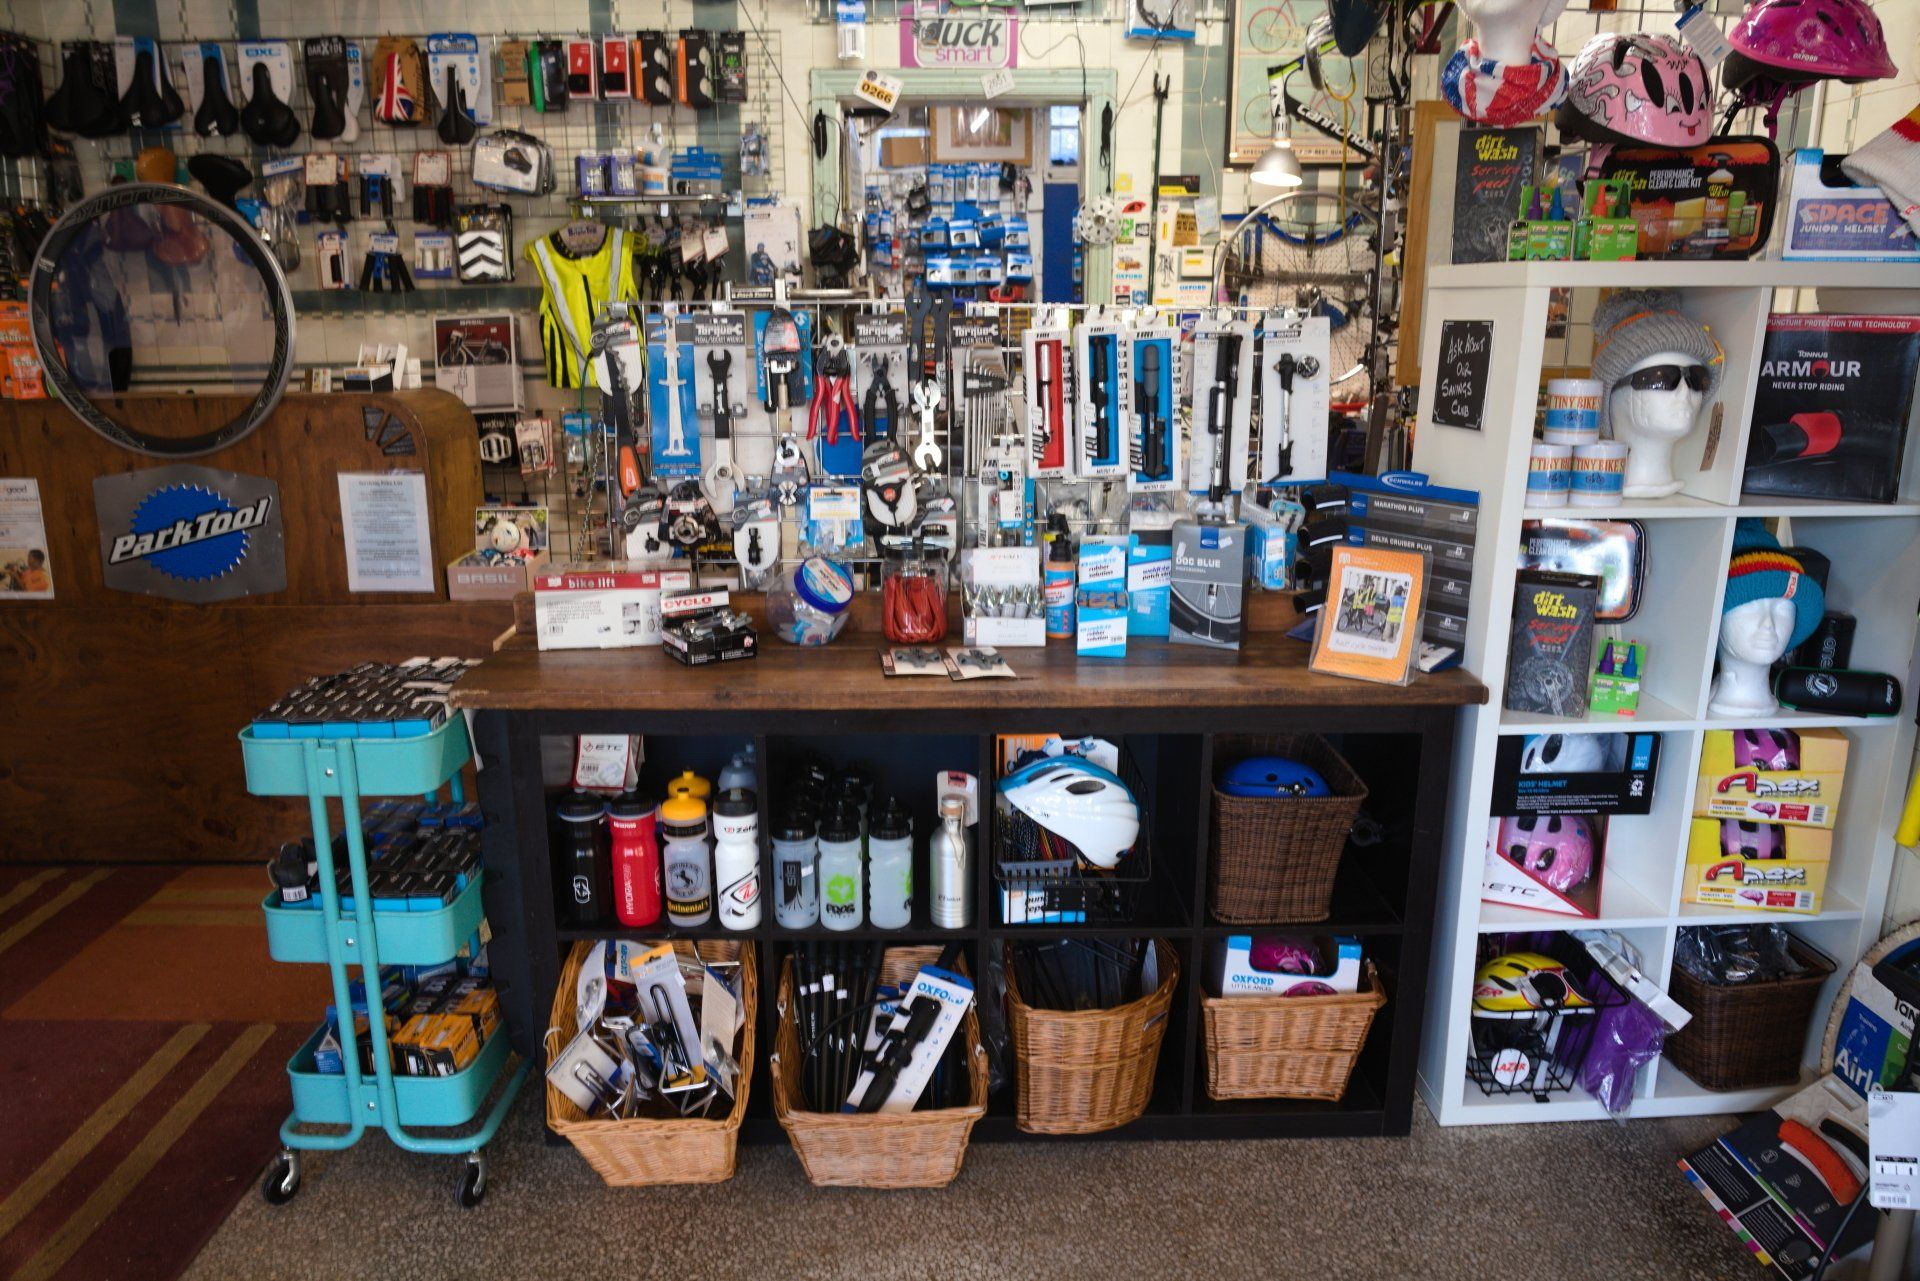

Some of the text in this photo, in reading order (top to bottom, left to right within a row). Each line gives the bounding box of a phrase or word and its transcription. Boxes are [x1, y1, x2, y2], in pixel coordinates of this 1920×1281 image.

[935, 46, 992, 62] smart
[1792, 53, 1818, 62] OXFORD
[860, 79, 894, 105] 0266
[1475, 135, 1506, 150] dirt
[1478, 145, 1519, 161] wash
[1649, 168, 1695, 180] PERFORMANCE
[1648, 179, 1669, 189] CLEAN
[1804, 203, 1890, 224] SPACE
[1799, 224, 1886, 233] JUNIOR HELMET
[1804, 319, 1846, 328] PROTECTION
[1848, 320, 1863, 328] TIRE
[1865, 321, 1911, 329] TECHNOLOGY
[856, 325, 896, 340] Torqu
[1772, 381, 1845, 391] NEVER STOP RIDING
[1554, 395, 1575, 409] TINY
[1538, 457, 1559, 471] TINY
[1577, 457, 1597, 471] TINY
[1600, 457, 1625, 472] BIKES
[1388, 476, 1424, 487] SCHWALBE
[1373, 500, 1425, 515] MARATHON PLUS
[1371, 534, 1433, 551] DELTA CRUISER PLUS
[1196, 557, 1221, 568] BLUE
[457, 573, 517, 584] BASIL
[568, 577, 616, 589] bike lift
[664, 596, 712, 609] CYCLO
[1533, 591, 1565, 606] dirt
[1536, 603, 1578, 619] wash
[1538, 780, 1568, 788] HELMET
[1489, 882, 1540, 897] ETC
[1231, 973, 1274, 986] OXFORD
